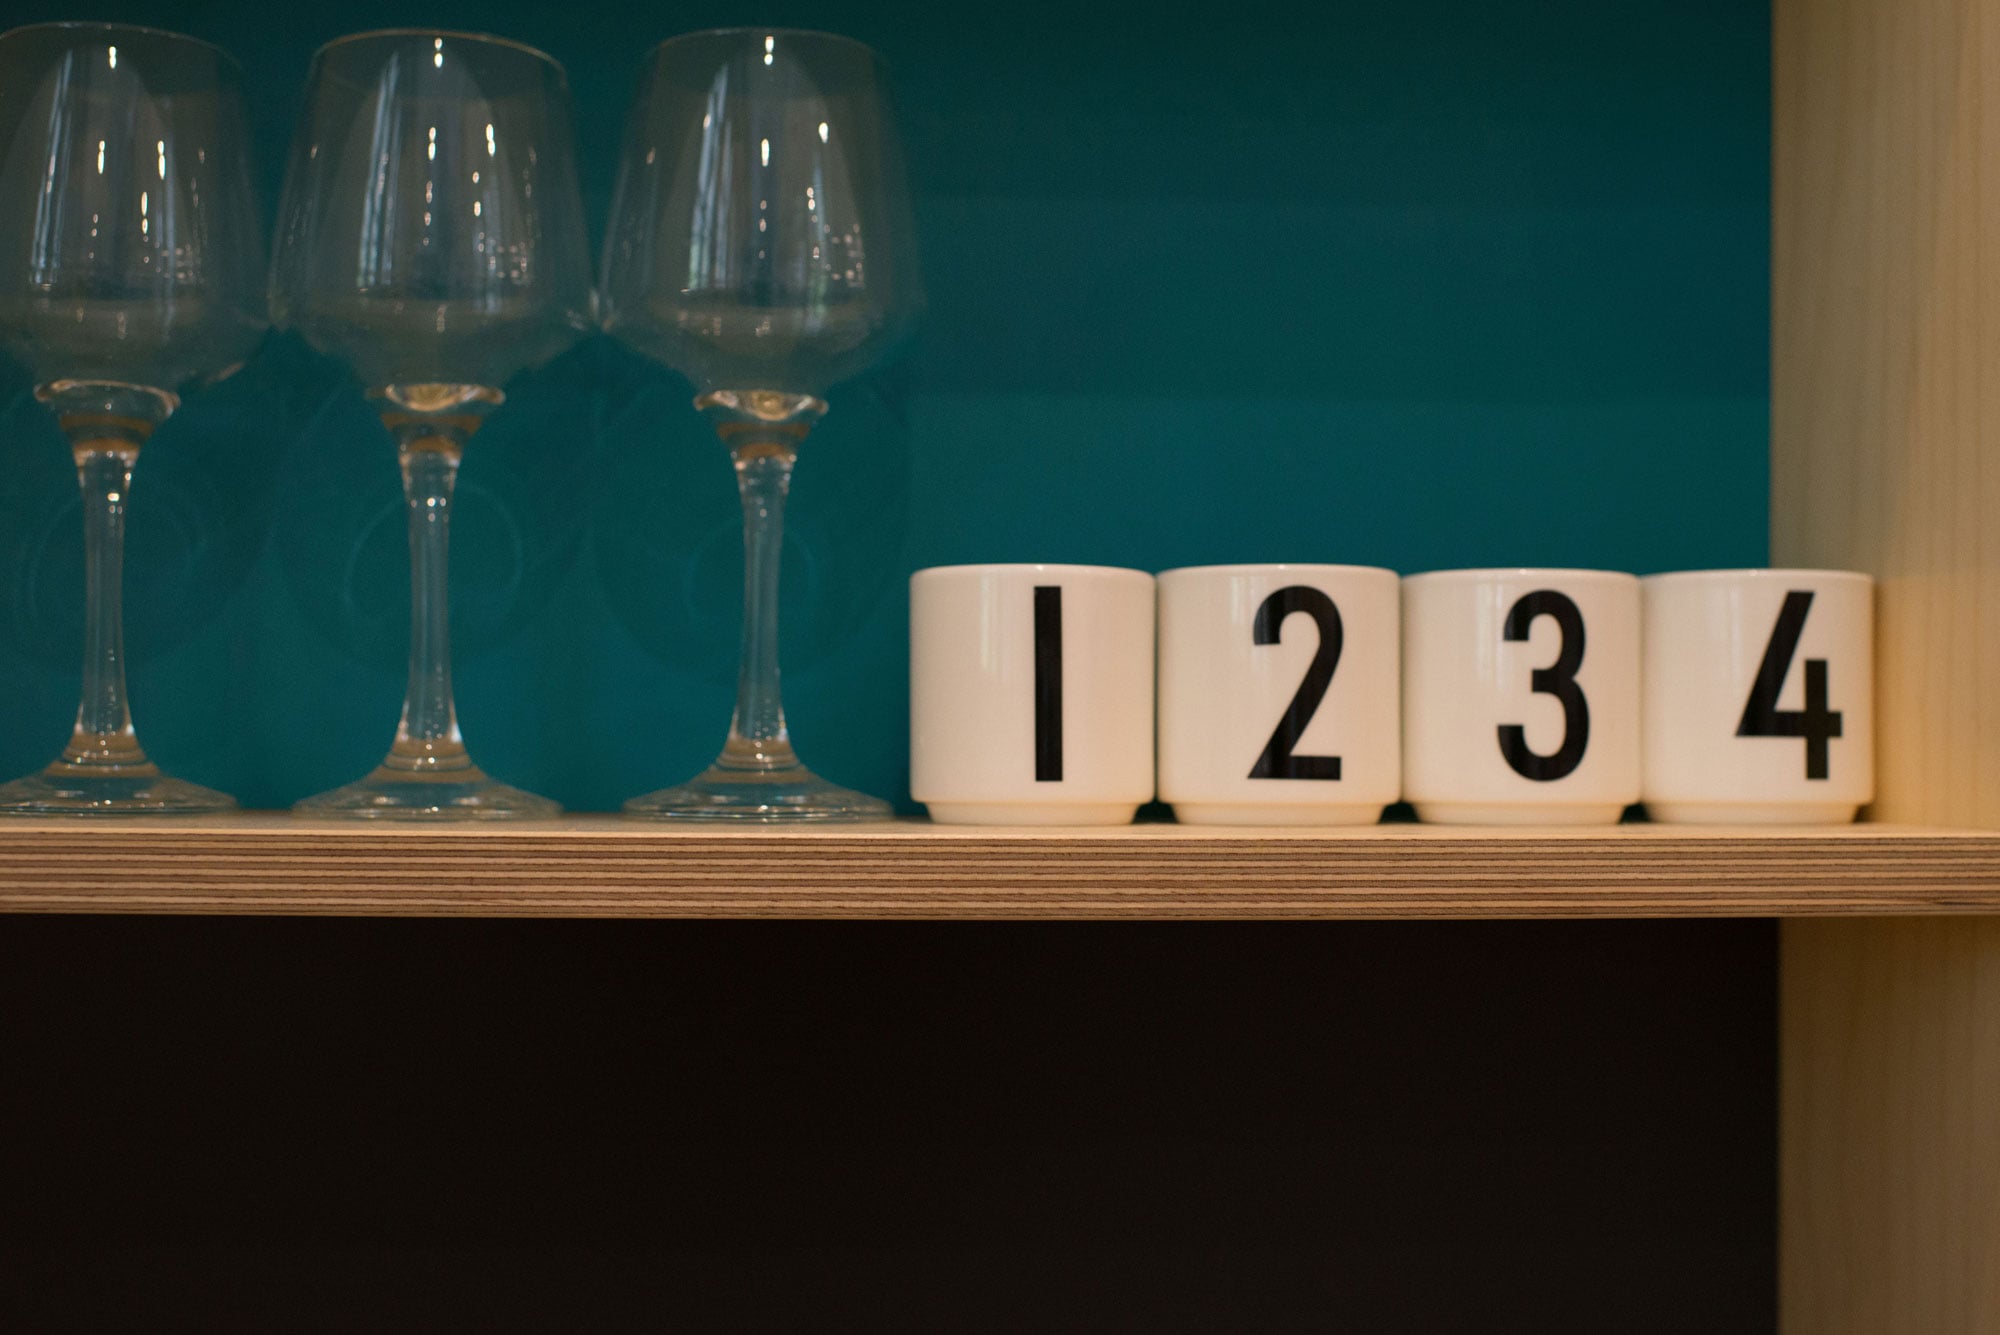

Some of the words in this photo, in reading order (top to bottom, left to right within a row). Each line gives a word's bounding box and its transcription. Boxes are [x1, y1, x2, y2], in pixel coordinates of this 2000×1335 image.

[1033, 585, 1063, 782] 1
[1247, 585, 1344, 782] 2
[1497, 589, 1590, 783] 3
[1735, 590, 1843, 781] 4
